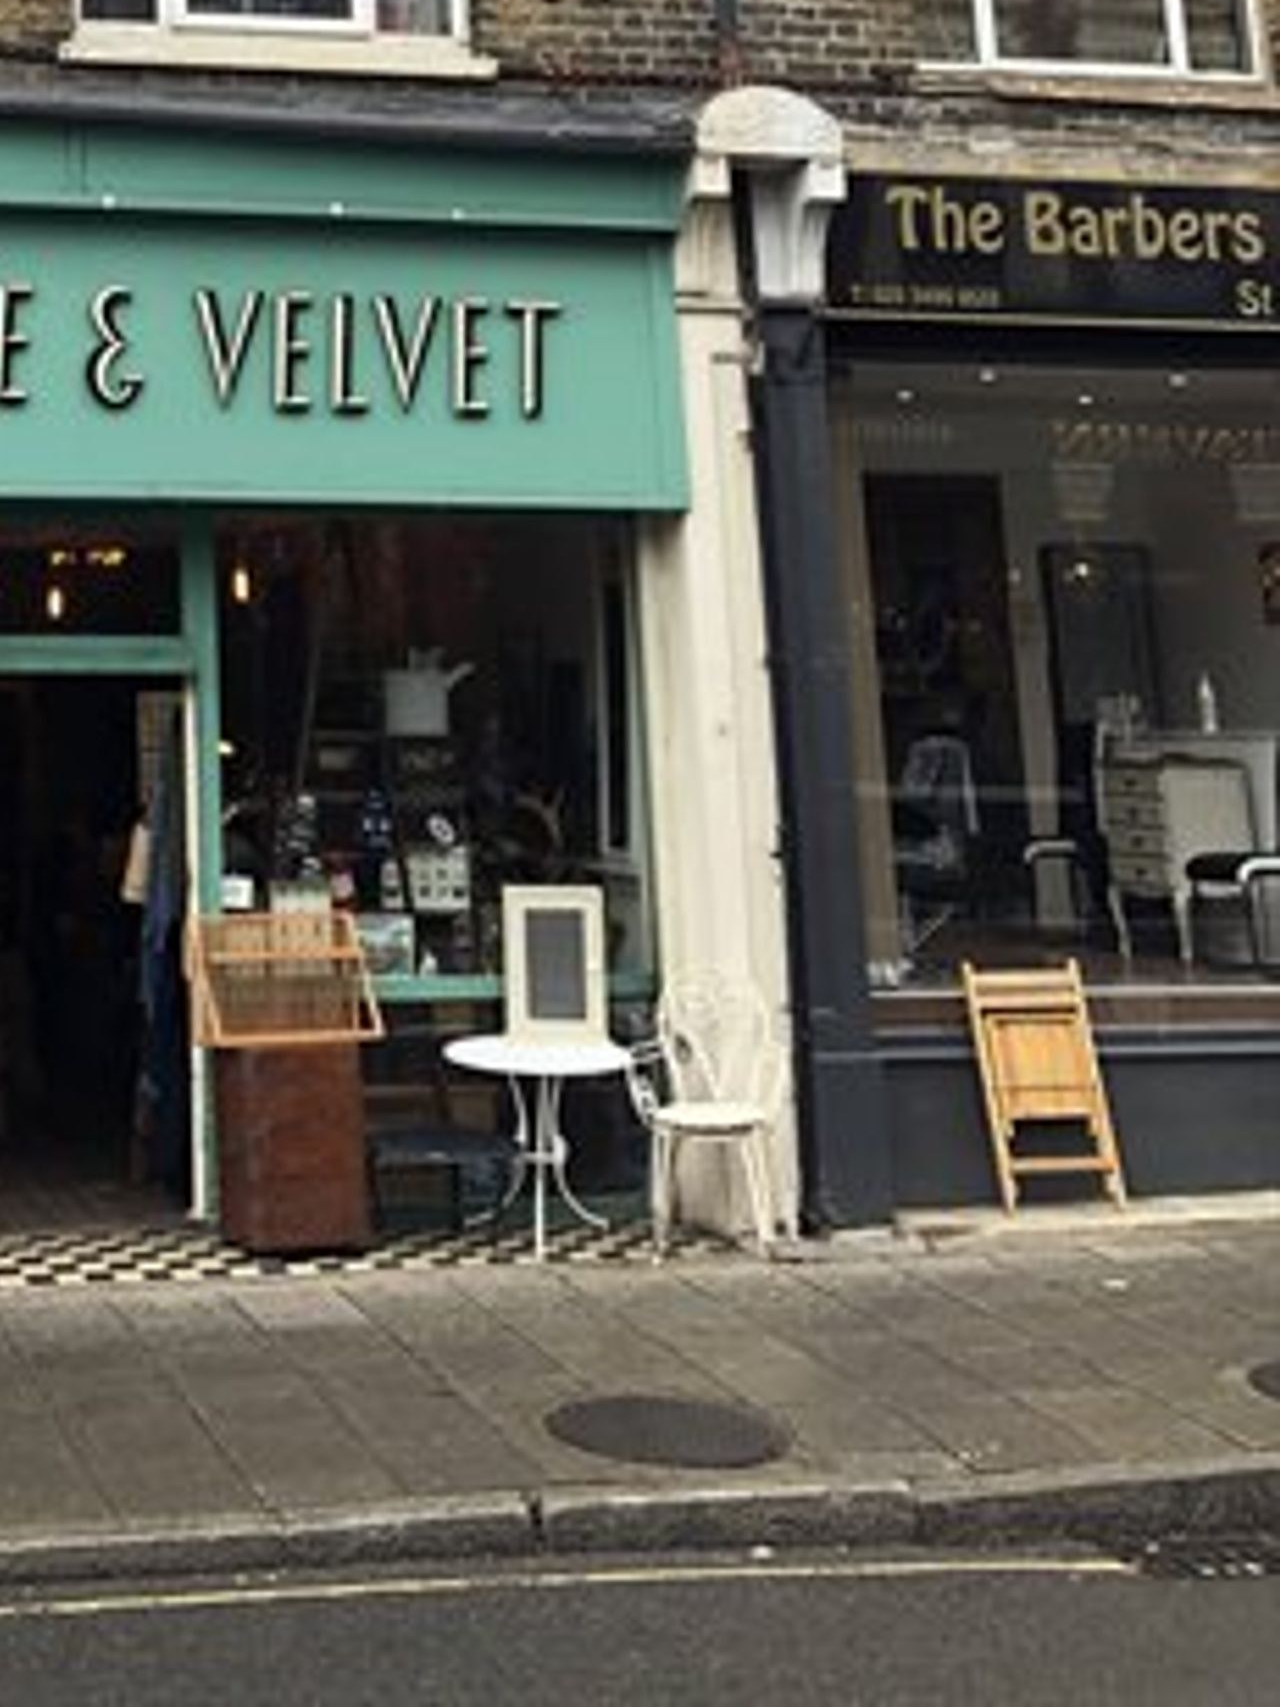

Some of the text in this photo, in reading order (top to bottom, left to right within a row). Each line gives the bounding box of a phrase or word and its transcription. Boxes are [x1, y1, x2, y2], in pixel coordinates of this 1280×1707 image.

[886, 186, 1265, 262] The Barbers
[86, 284, 146, 412] &
[195, 289, 563, 421] VELVET
